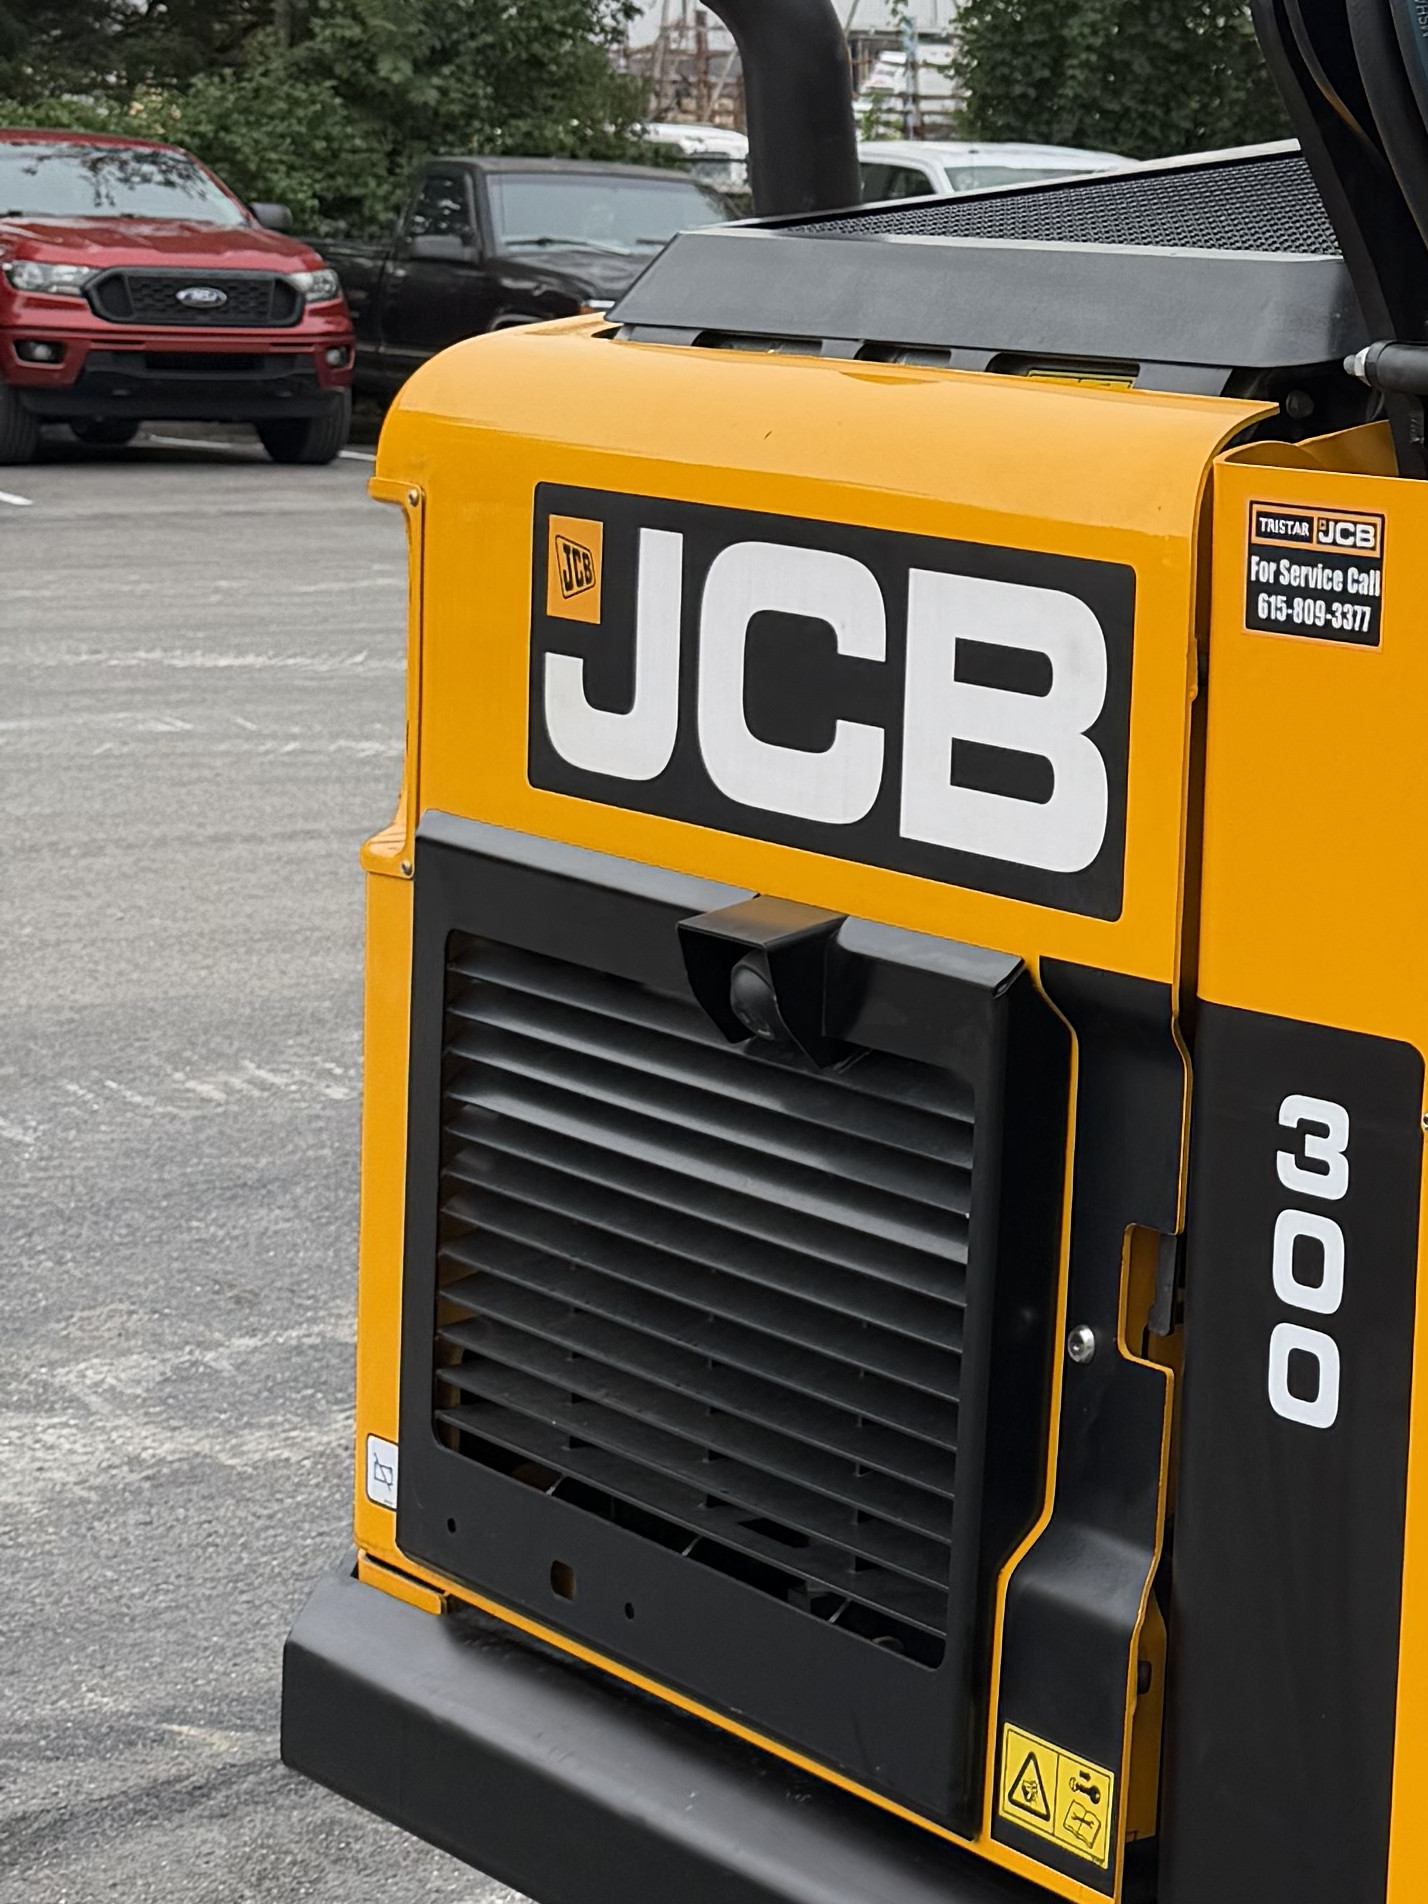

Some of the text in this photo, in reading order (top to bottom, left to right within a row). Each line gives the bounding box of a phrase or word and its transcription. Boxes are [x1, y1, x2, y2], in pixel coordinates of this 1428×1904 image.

[1259, 517, 1375, 548] TRISTAR JCB
[562, 542, 593, 592] JCB
[1250, 555, 1381, 597] For Service Call
[1257, 593, 1372, 632] 615-809-3377
[542, 527, 1110, 874] JCB
[1267, 1094, 1351, 1431] 300
